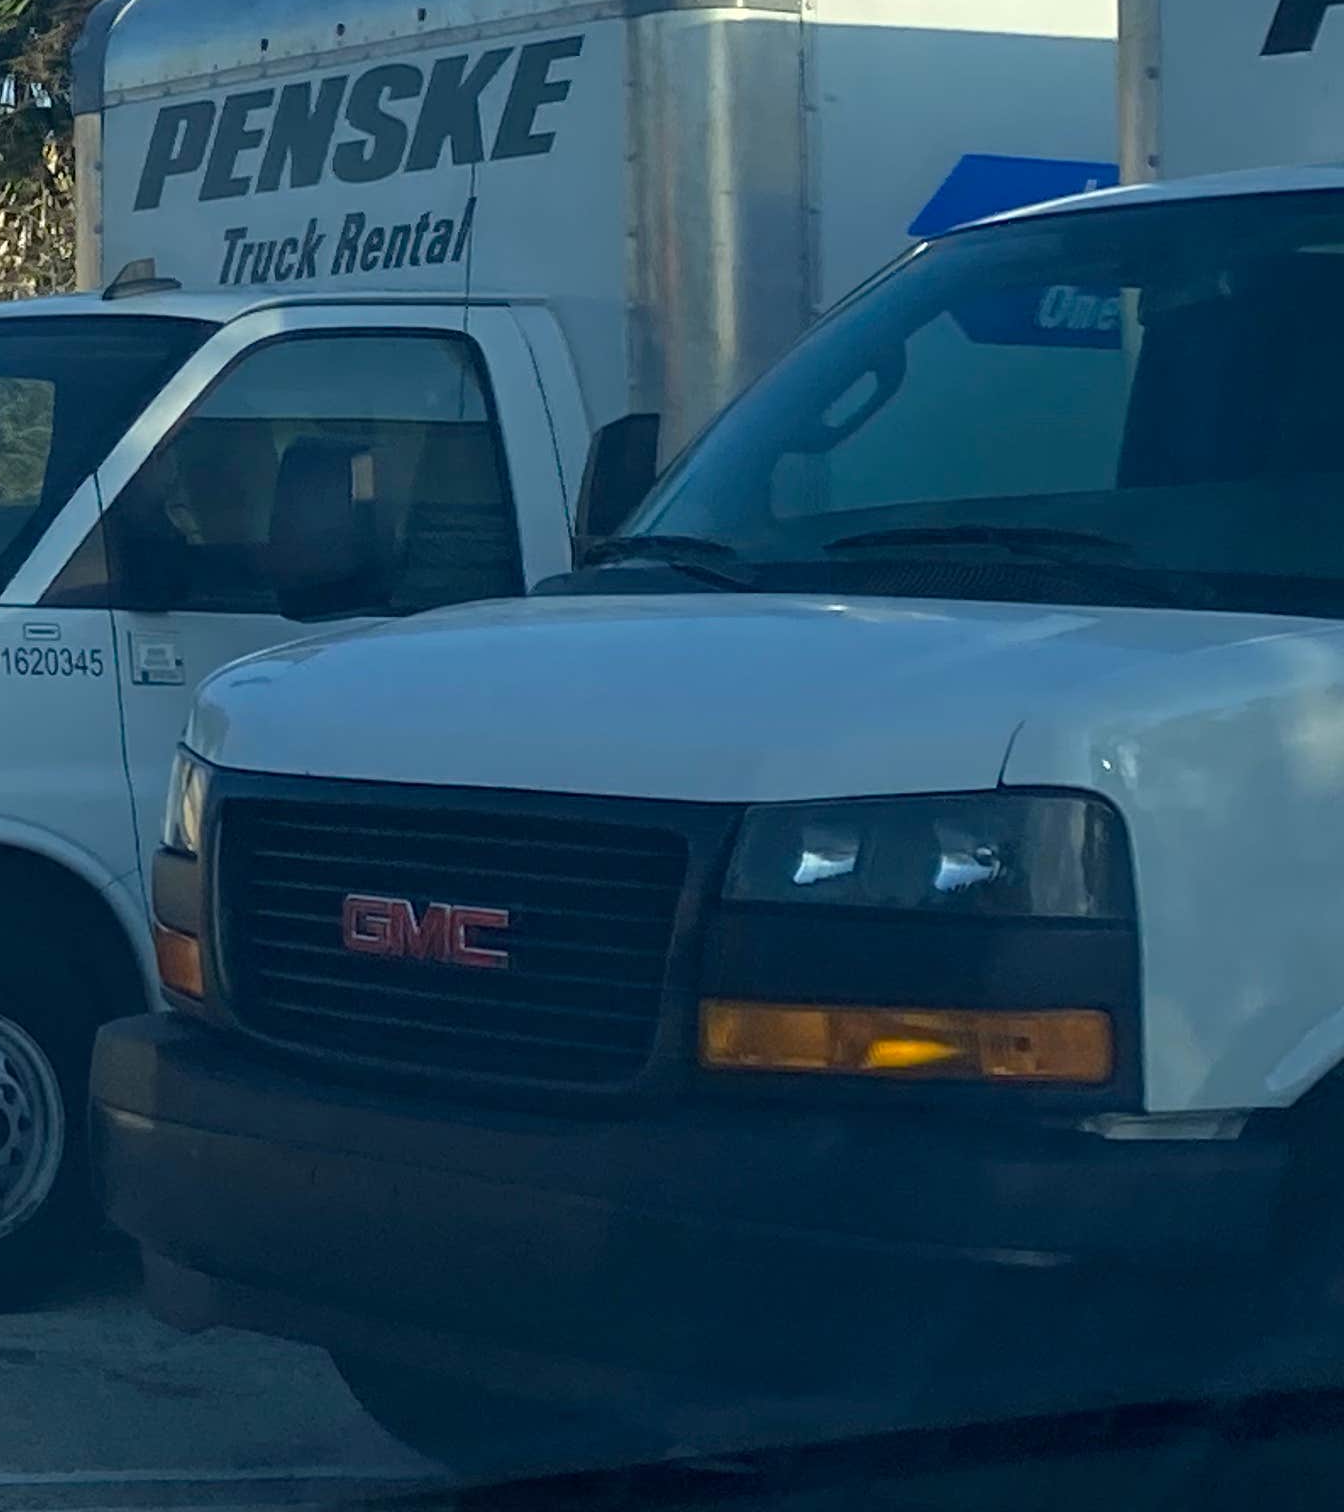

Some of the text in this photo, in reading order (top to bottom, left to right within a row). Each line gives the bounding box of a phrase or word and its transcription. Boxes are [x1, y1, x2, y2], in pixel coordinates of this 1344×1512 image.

[133, 34, 585, 212] PENSKE
[219, 196, 477, 286] Truck Rental
[343, 893, 509, 969] GMC
